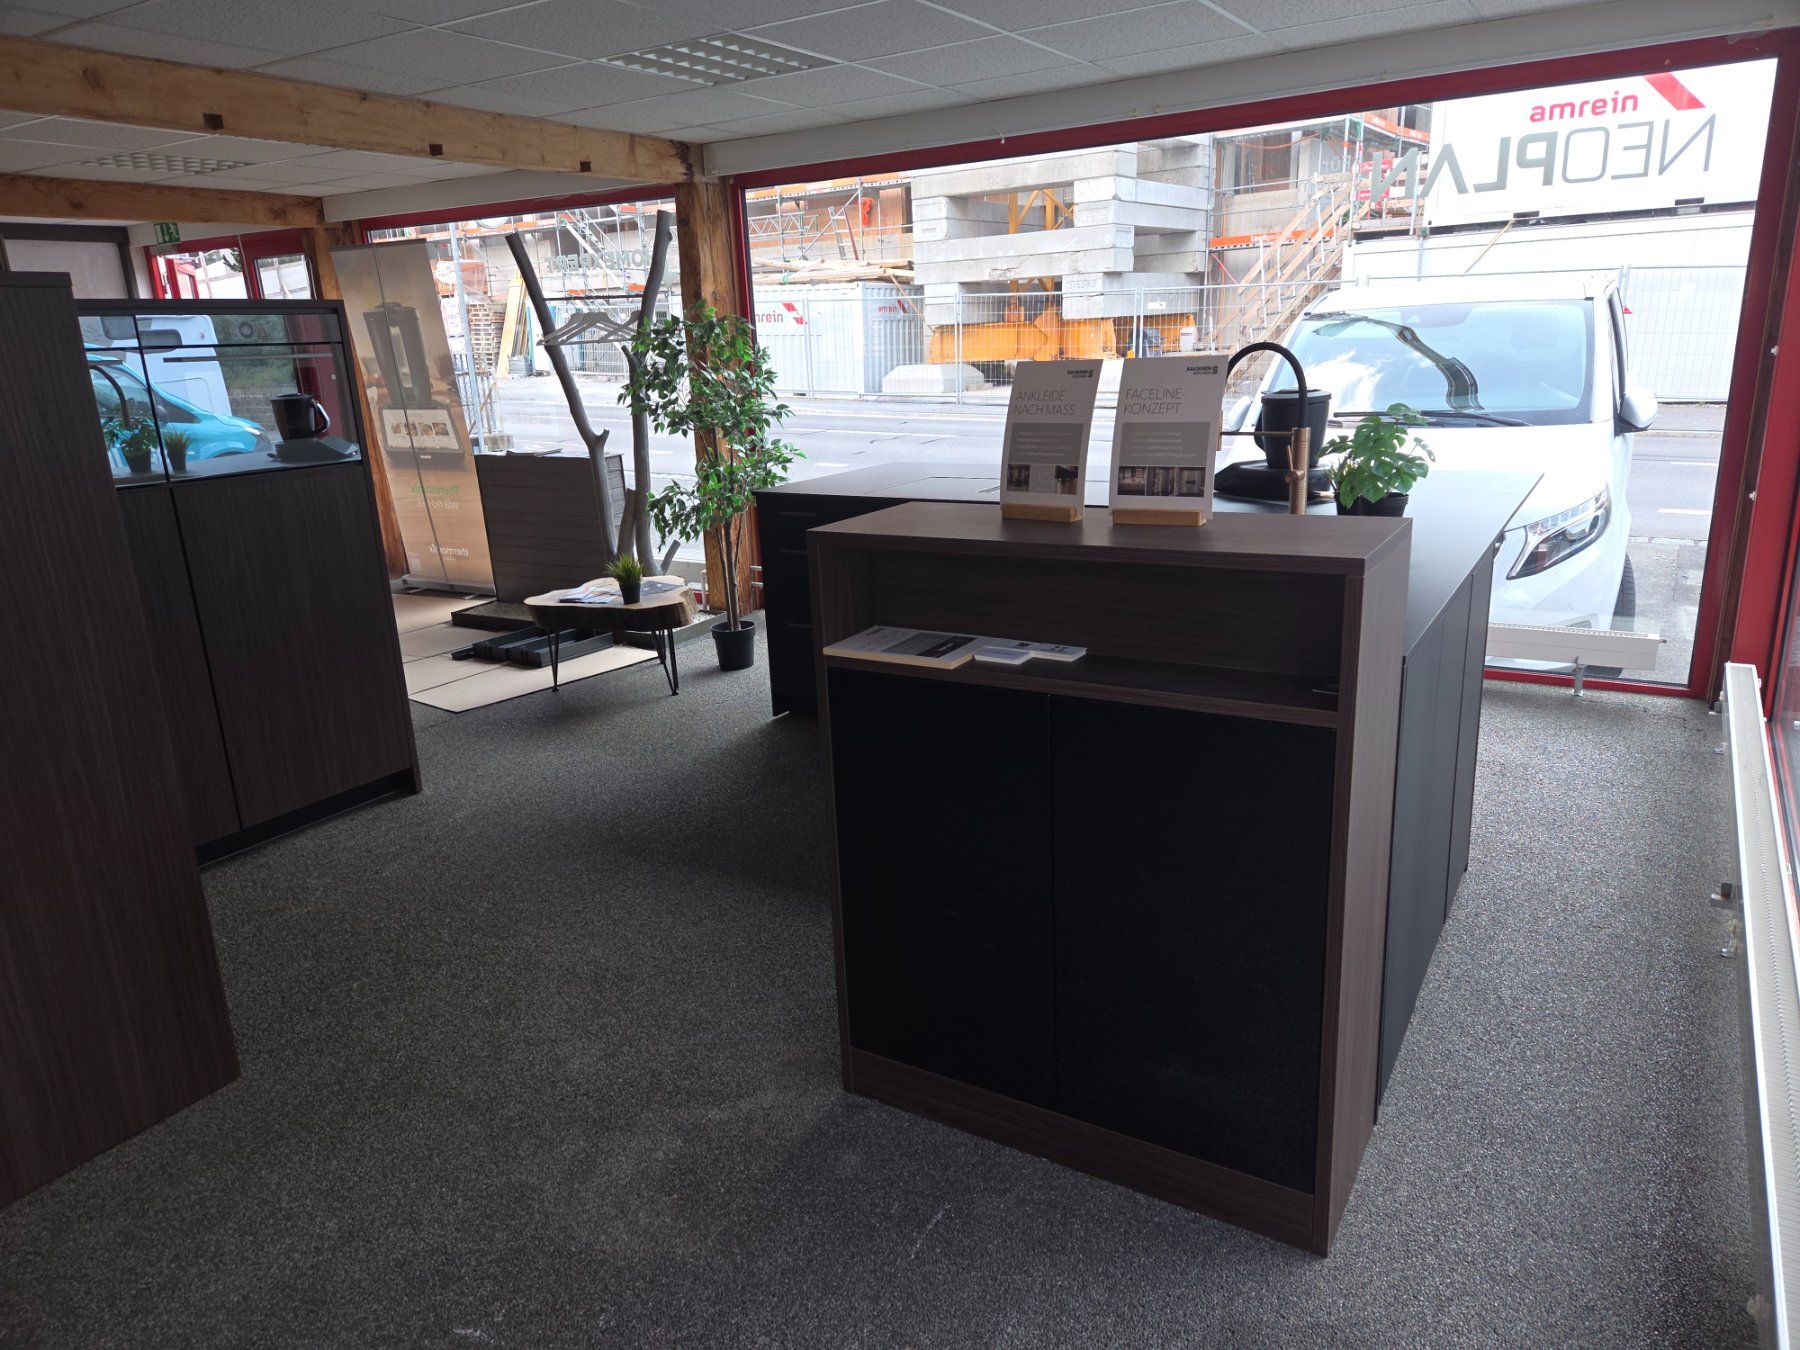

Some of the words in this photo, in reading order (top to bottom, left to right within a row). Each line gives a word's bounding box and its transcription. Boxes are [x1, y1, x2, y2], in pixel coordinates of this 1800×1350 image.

[1529, 89, 1639, 123] amrein
[755, 310, 784, 323] mrein
[1016, 390, 1067, 401] ANKLEIDE
[1126, 387, 1187, 401] FACELINE-
[1013, 403, 1044, 416] NACH
[1045, 404, 1077, 416] MASS
[1123, 402, 1183, 415] KONZEPT
